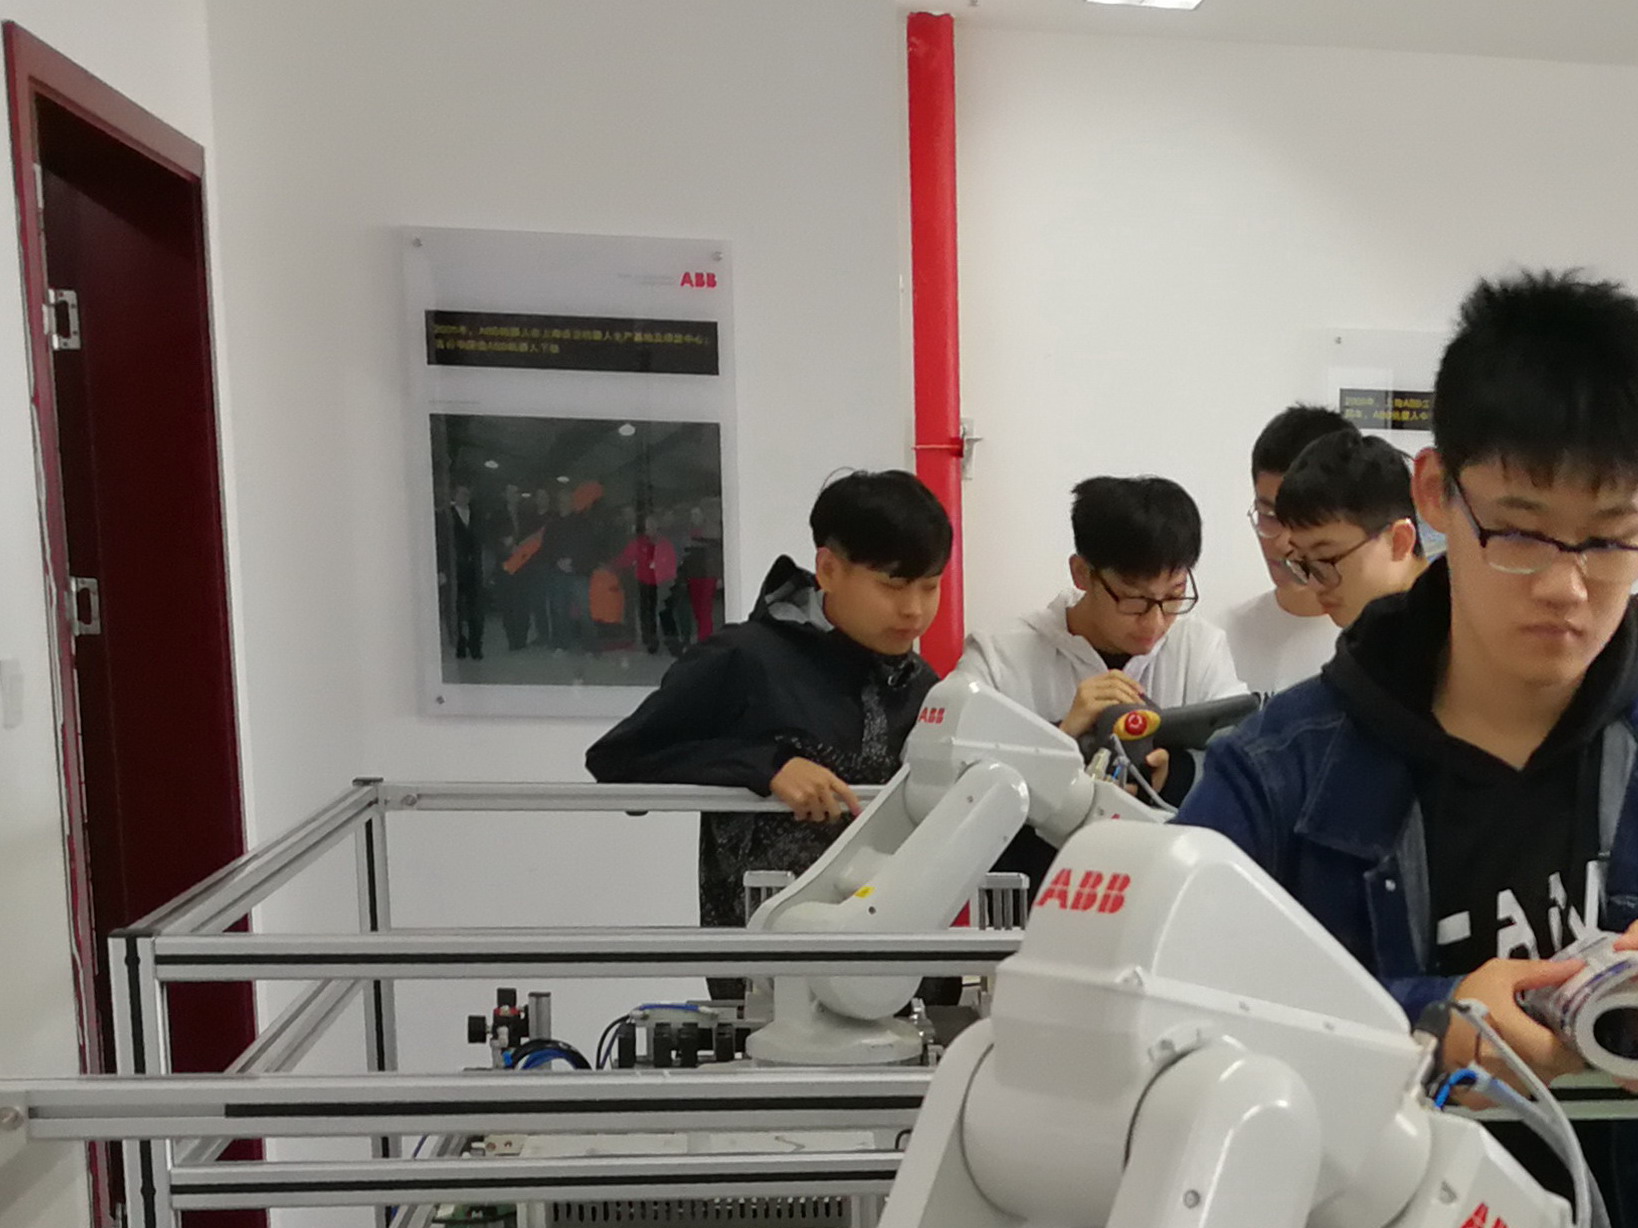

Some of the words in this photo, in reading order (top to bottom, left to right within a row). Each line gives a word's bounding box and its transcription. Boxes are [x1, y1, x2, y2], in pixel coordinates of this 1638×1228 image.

[680, 271, 717, 289] ABB
[917, 706, 945, 724] ABB
[1035, 868, 1131, 914] ABB
